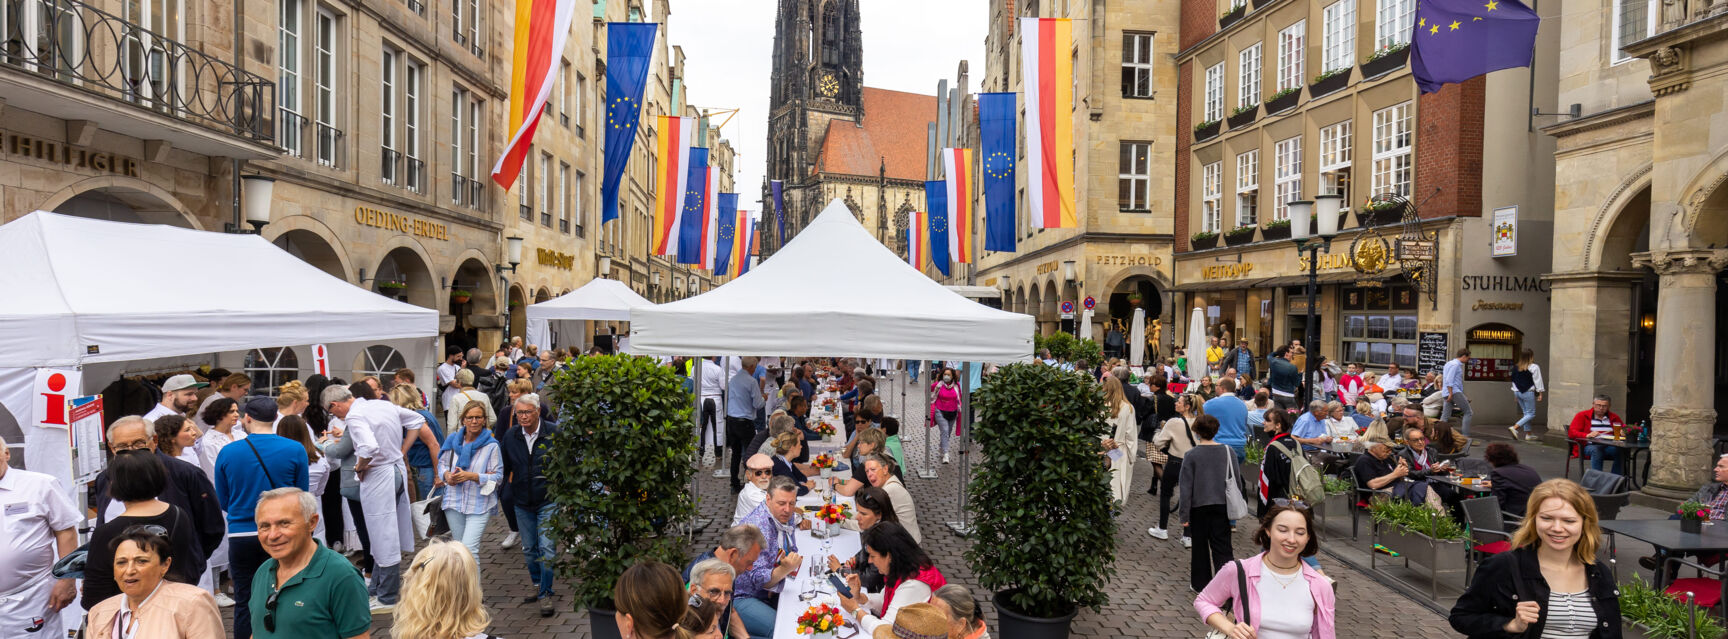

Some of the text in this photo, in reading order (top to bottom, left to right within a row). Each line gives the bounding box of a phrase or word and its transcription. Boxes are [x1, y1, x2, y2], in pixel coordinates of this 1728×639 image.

[10, 135, 139, 177] HILFIGER
[355, 206, 449, 241] OEDING-ERDEL
[1096, 255, 1162, 267] PETZHOLD
[1202, 262, 1253, 280] WEITKAMP
[1462, 275, 1552, 293] STUHLMAC
